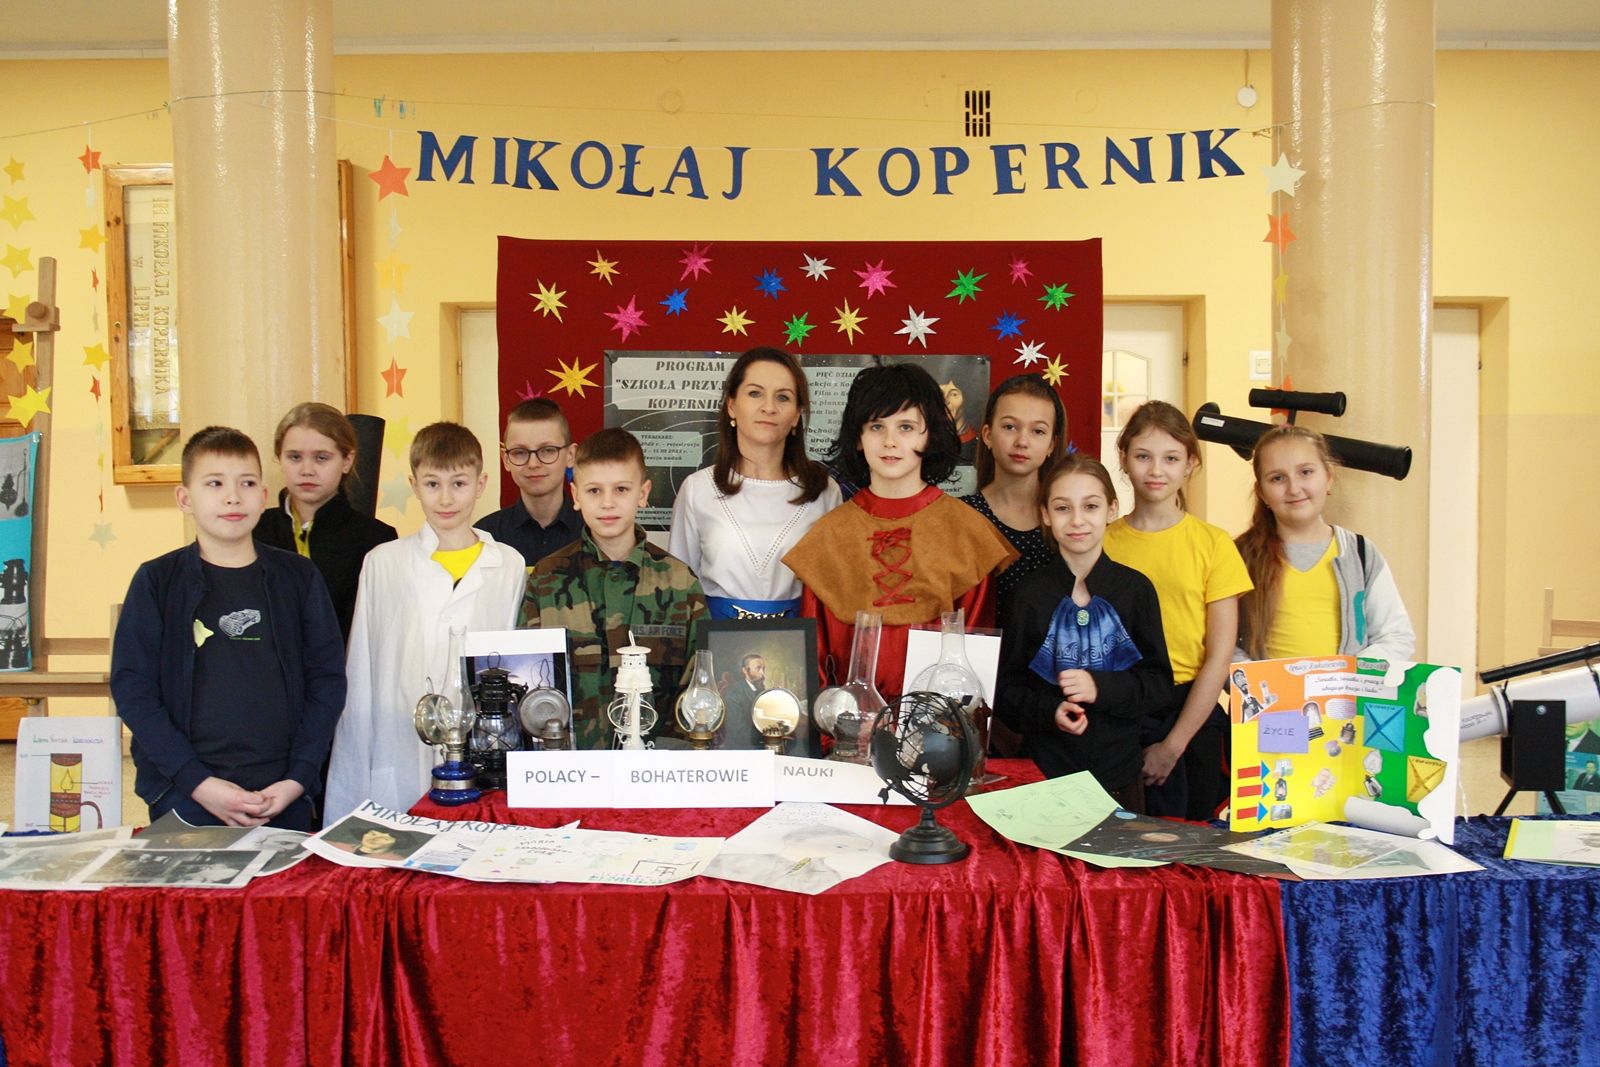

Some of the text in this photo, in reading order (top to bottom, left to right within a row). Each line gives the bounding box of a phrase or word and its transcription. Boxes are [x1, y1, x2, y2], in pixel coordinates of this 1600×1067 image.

[416, 128, 1245, 200] MIKOŁAJ KOPERNIK
[152, 222, 170, 298] MIKOŁAJA
[153, 305, 171, 397] KOPERNIKA
[656, 360, 725, 372] PROGRAM
[616, 379, 676, 390] "SZKOŁA
[525, 770, 586, 784] POLACY
[630, 769, 749, 784] BOHATEROWIE
[782, 765, 834, 778] NAUKI
